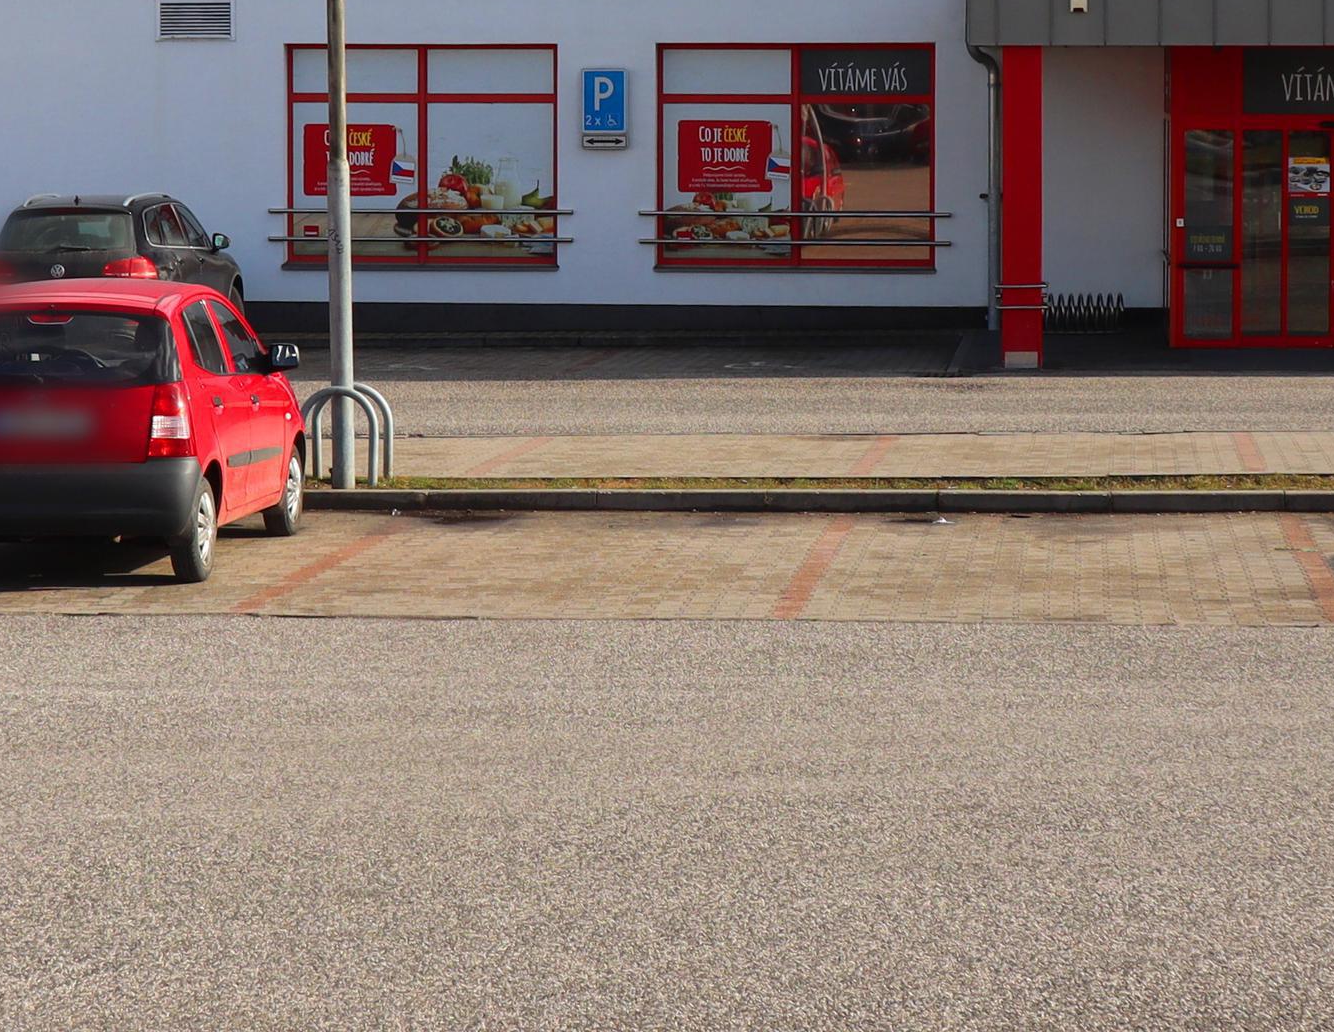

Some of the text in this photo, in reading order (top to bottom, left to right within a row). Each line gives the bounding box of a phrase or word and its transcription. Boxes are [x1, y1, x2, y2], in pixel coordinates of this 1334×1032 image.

[818, 61, 908, 92] VÍTÁME VÁS
[594, 76, 614, 111] P
[348, 128, 376, 147] ČESKÉ,
[724, 124, 751, 143] ČESKÉ,
[348, 149, 375, 166] DOBRÉ
[700, 144, 751, 163] TO JE DOBRÉ
